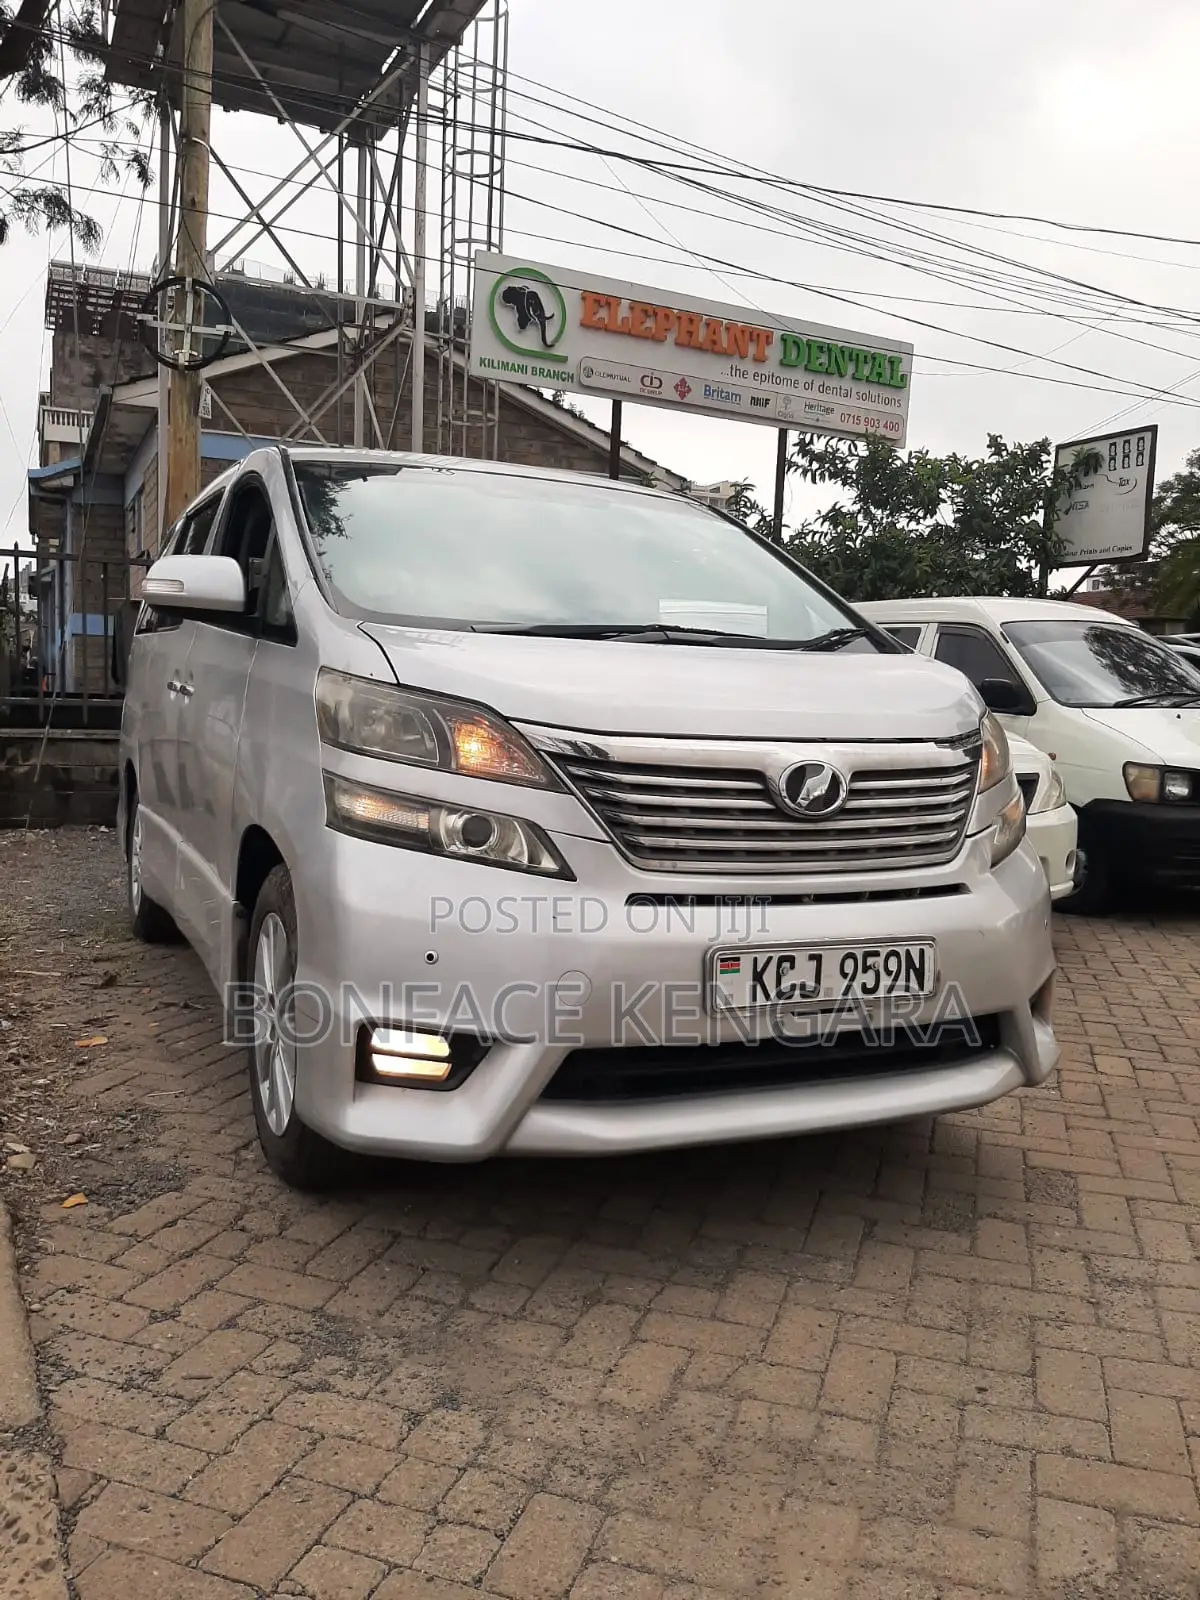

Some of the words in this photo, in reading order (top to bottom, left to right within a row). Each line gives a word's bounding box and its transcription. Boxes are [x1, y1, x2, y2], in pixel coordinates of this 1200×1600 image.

[580, 291, 773, 363] ELEPHANT
[779, 333, 908, 389] DENTAL
[479, 356, 529, 375] KILIMANI
[531, 366, 575, 383] BRANCH
[703, 384, 742, 401] Britam
[752, 371, 799, 390] epitome
[803, 379, 816, 392] of
[818, 382, 853, 400] dental
[855, 390, 902, 408] solutions
[804, 400, 835, 416] Heritage
[840, 412, 861, 427] 0715
[863, 417, 881, 431] 903
[882, 420, 900, 433] 400
[751, 953, 822, 1003] KCJ
[839, 948, 925, 996] 959N
